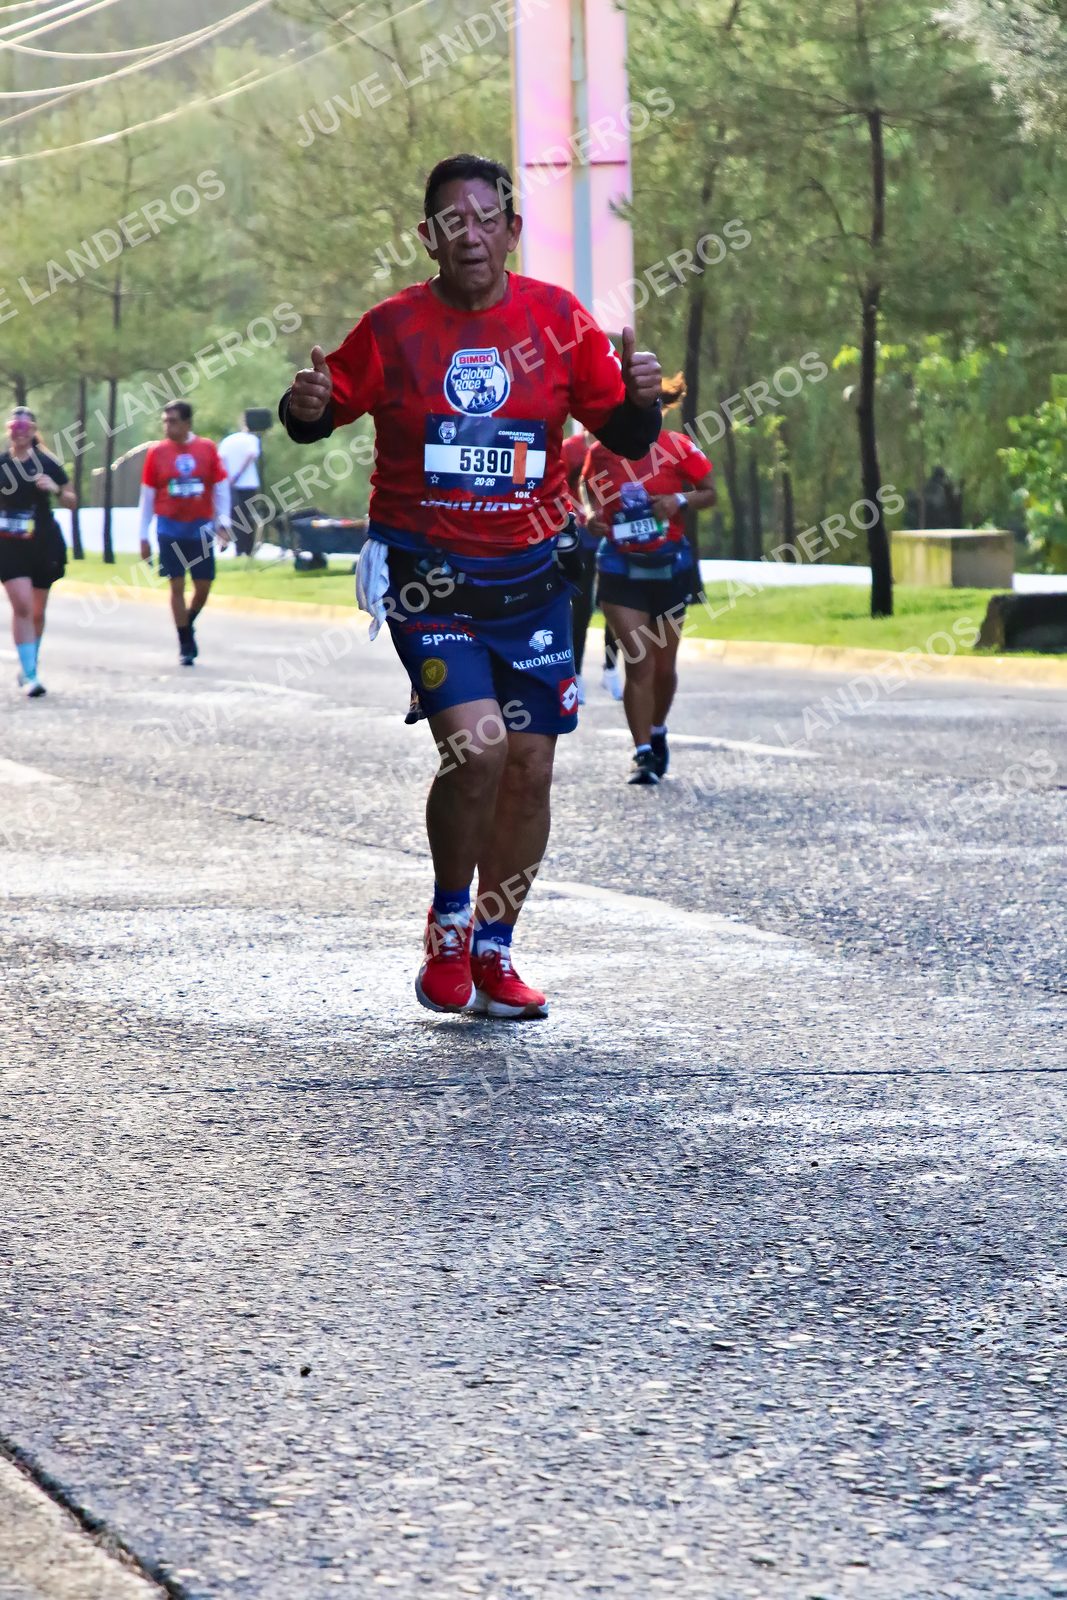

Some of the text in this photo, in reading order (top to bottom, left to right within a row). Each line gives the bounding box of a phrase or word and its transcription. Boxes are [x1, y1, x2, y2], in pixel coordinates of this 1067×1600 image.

[459, 355, 493, 365] BIMBO
[461, 367, 494, 380] Global
[455, 380, 482, 391] Race
[459, 447, 512, 475] 5390
[514, 491, 531, 499] 10K
